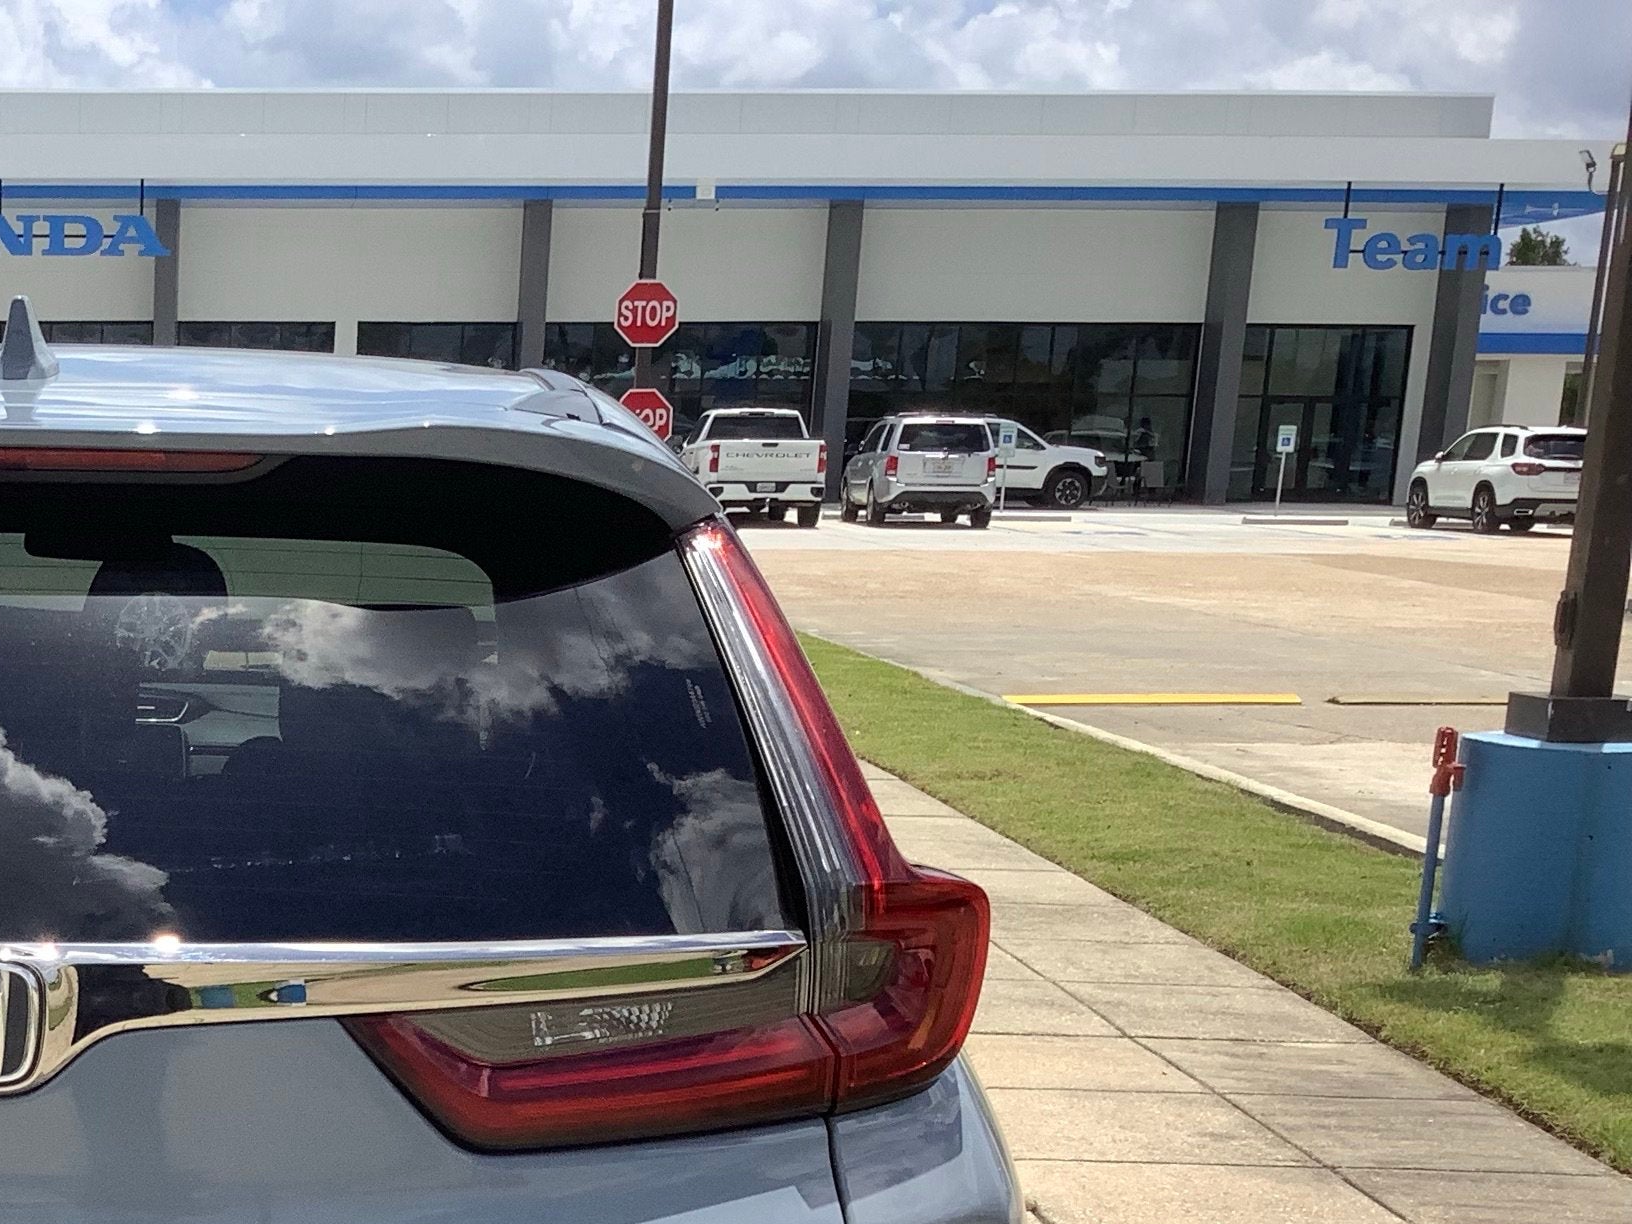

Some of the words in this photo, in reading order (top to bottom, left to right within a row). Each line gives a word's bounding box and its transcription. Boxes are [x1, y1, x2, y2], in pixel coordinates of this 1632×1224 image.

[1323, 217, 1503, 272] Team
[619, 299, 676, 328] STOP
[725, 451, 812, 459] CHEVROLET
